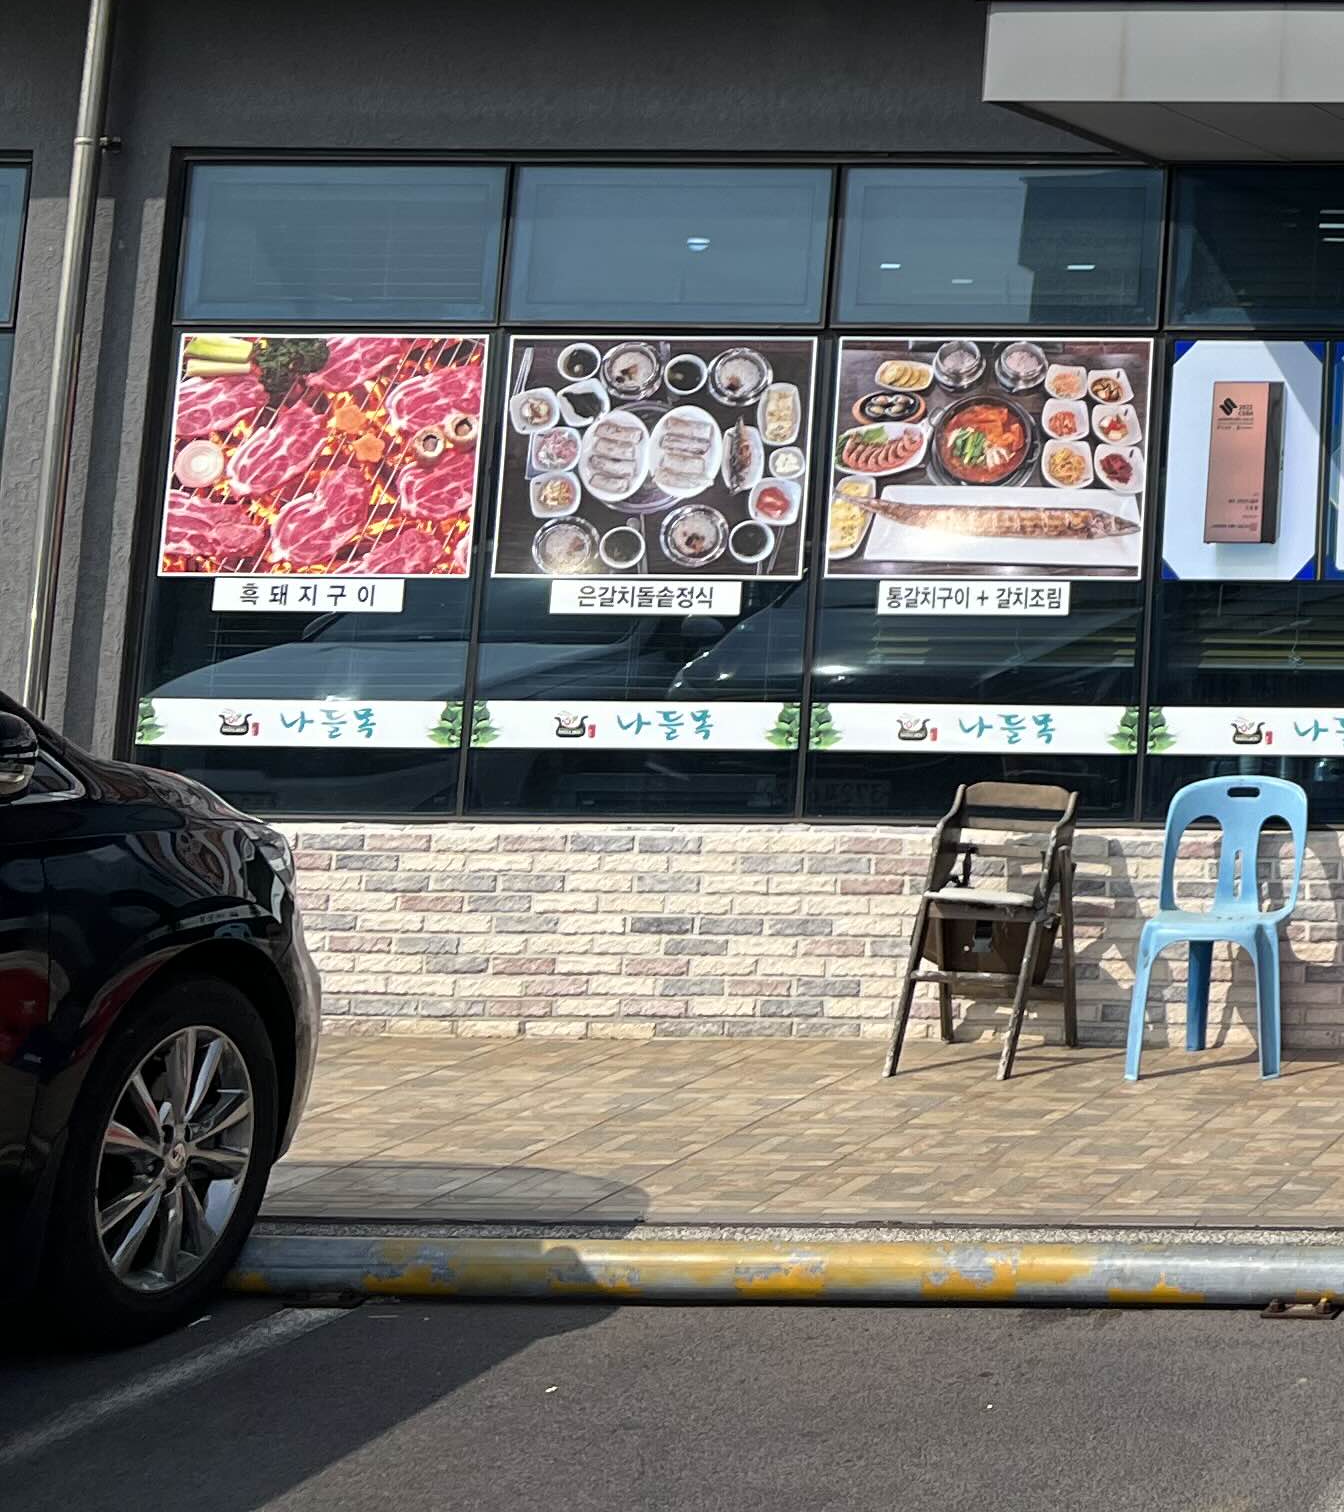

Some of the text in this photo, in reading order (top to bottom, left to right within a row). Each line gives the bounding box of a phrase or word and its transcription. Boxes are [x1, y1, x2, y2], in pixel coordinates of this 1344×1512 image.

[239, 582, 376, 607] 흑돼지구이
[577, 584, 715, 610] 은갈치돌솥정식
[885, 586, 1062, 611] 통갈치구이 + 갈치조림
[279, 707, 375, 740] 나들목
[616, 706, 716, 741] 나들목
[958, 712, 1057, 746] 나들목
